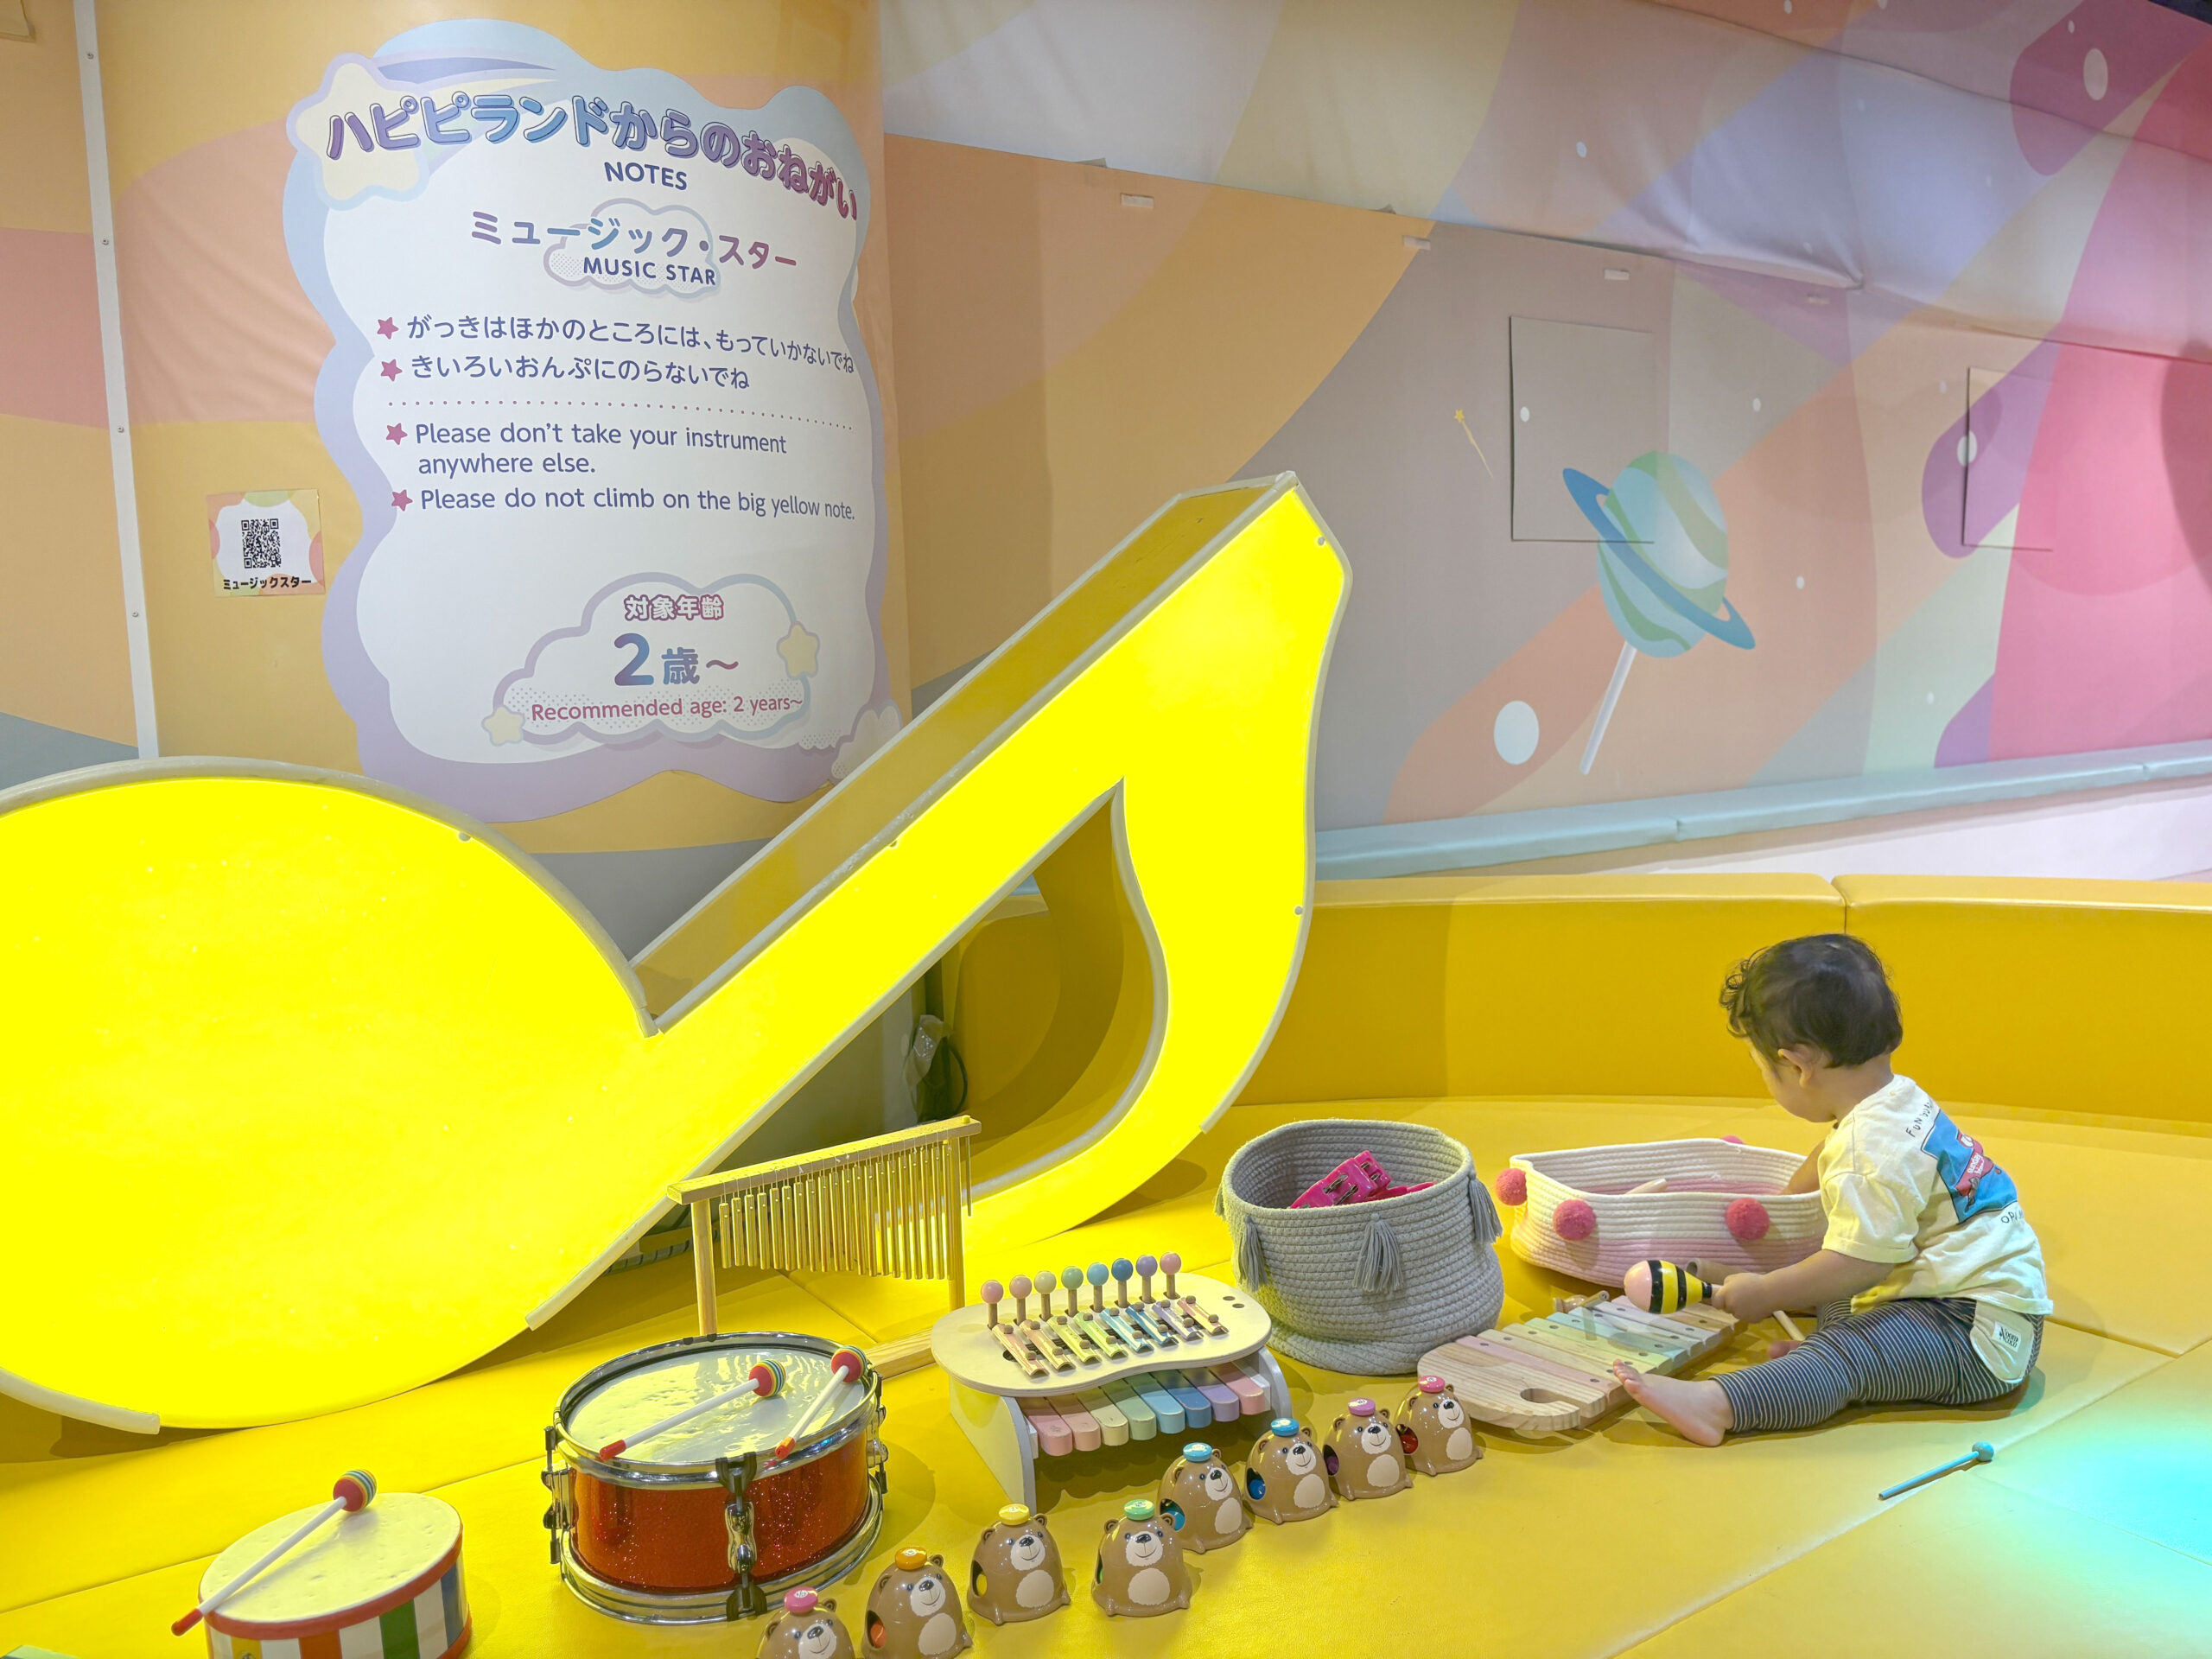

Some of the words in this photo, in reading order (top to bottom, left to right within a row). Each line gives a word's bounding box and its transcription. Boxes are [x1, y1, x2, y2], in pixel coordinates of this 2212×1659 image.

[327, 91, 857, 220] ハピピランドからのおねがい
[605, 162, 687, 190] NOTES
[472, 211, 797, 270] ミュージック・スター
[583, 257, 656, 278] MUSIC
[666, 264, 715, 285] STAR
[407, 314, 855, 373] がっきはほかのところには、もっていかないでね
[412, 355, 749, 389] きいろいおんぷにのらないでね
[416, 423, 491, 444] Please
[500, 423, 563, 443] don't
[571, 423, 621, 444] take
[630, 429, 677, 449] your
[686, 427, 787, 454] instrument
[418, 453, 532, 479] anywhere
[543, 453, 595, 473] else.
[421, 489, 495, 510] Please
[505, 487, 536, 507] do
[545, 488, 585, 507] not
[594, 487, 654, 508] climb
[663, 494, 690, 509] on
[697, 490, 731, 510] the
[738, 492, 766, 517] big
[772, 495, 820, 518] yellow
[824, 501, 855, 520] note.
[223, 576, 311, 590] ミュージックスター
[623, 594, 724, 621] 対象年齢
[531, 698, 683, 721] Recommended
[691, 699, 727, 718] age:
[734, 696, 744, 712] 2
